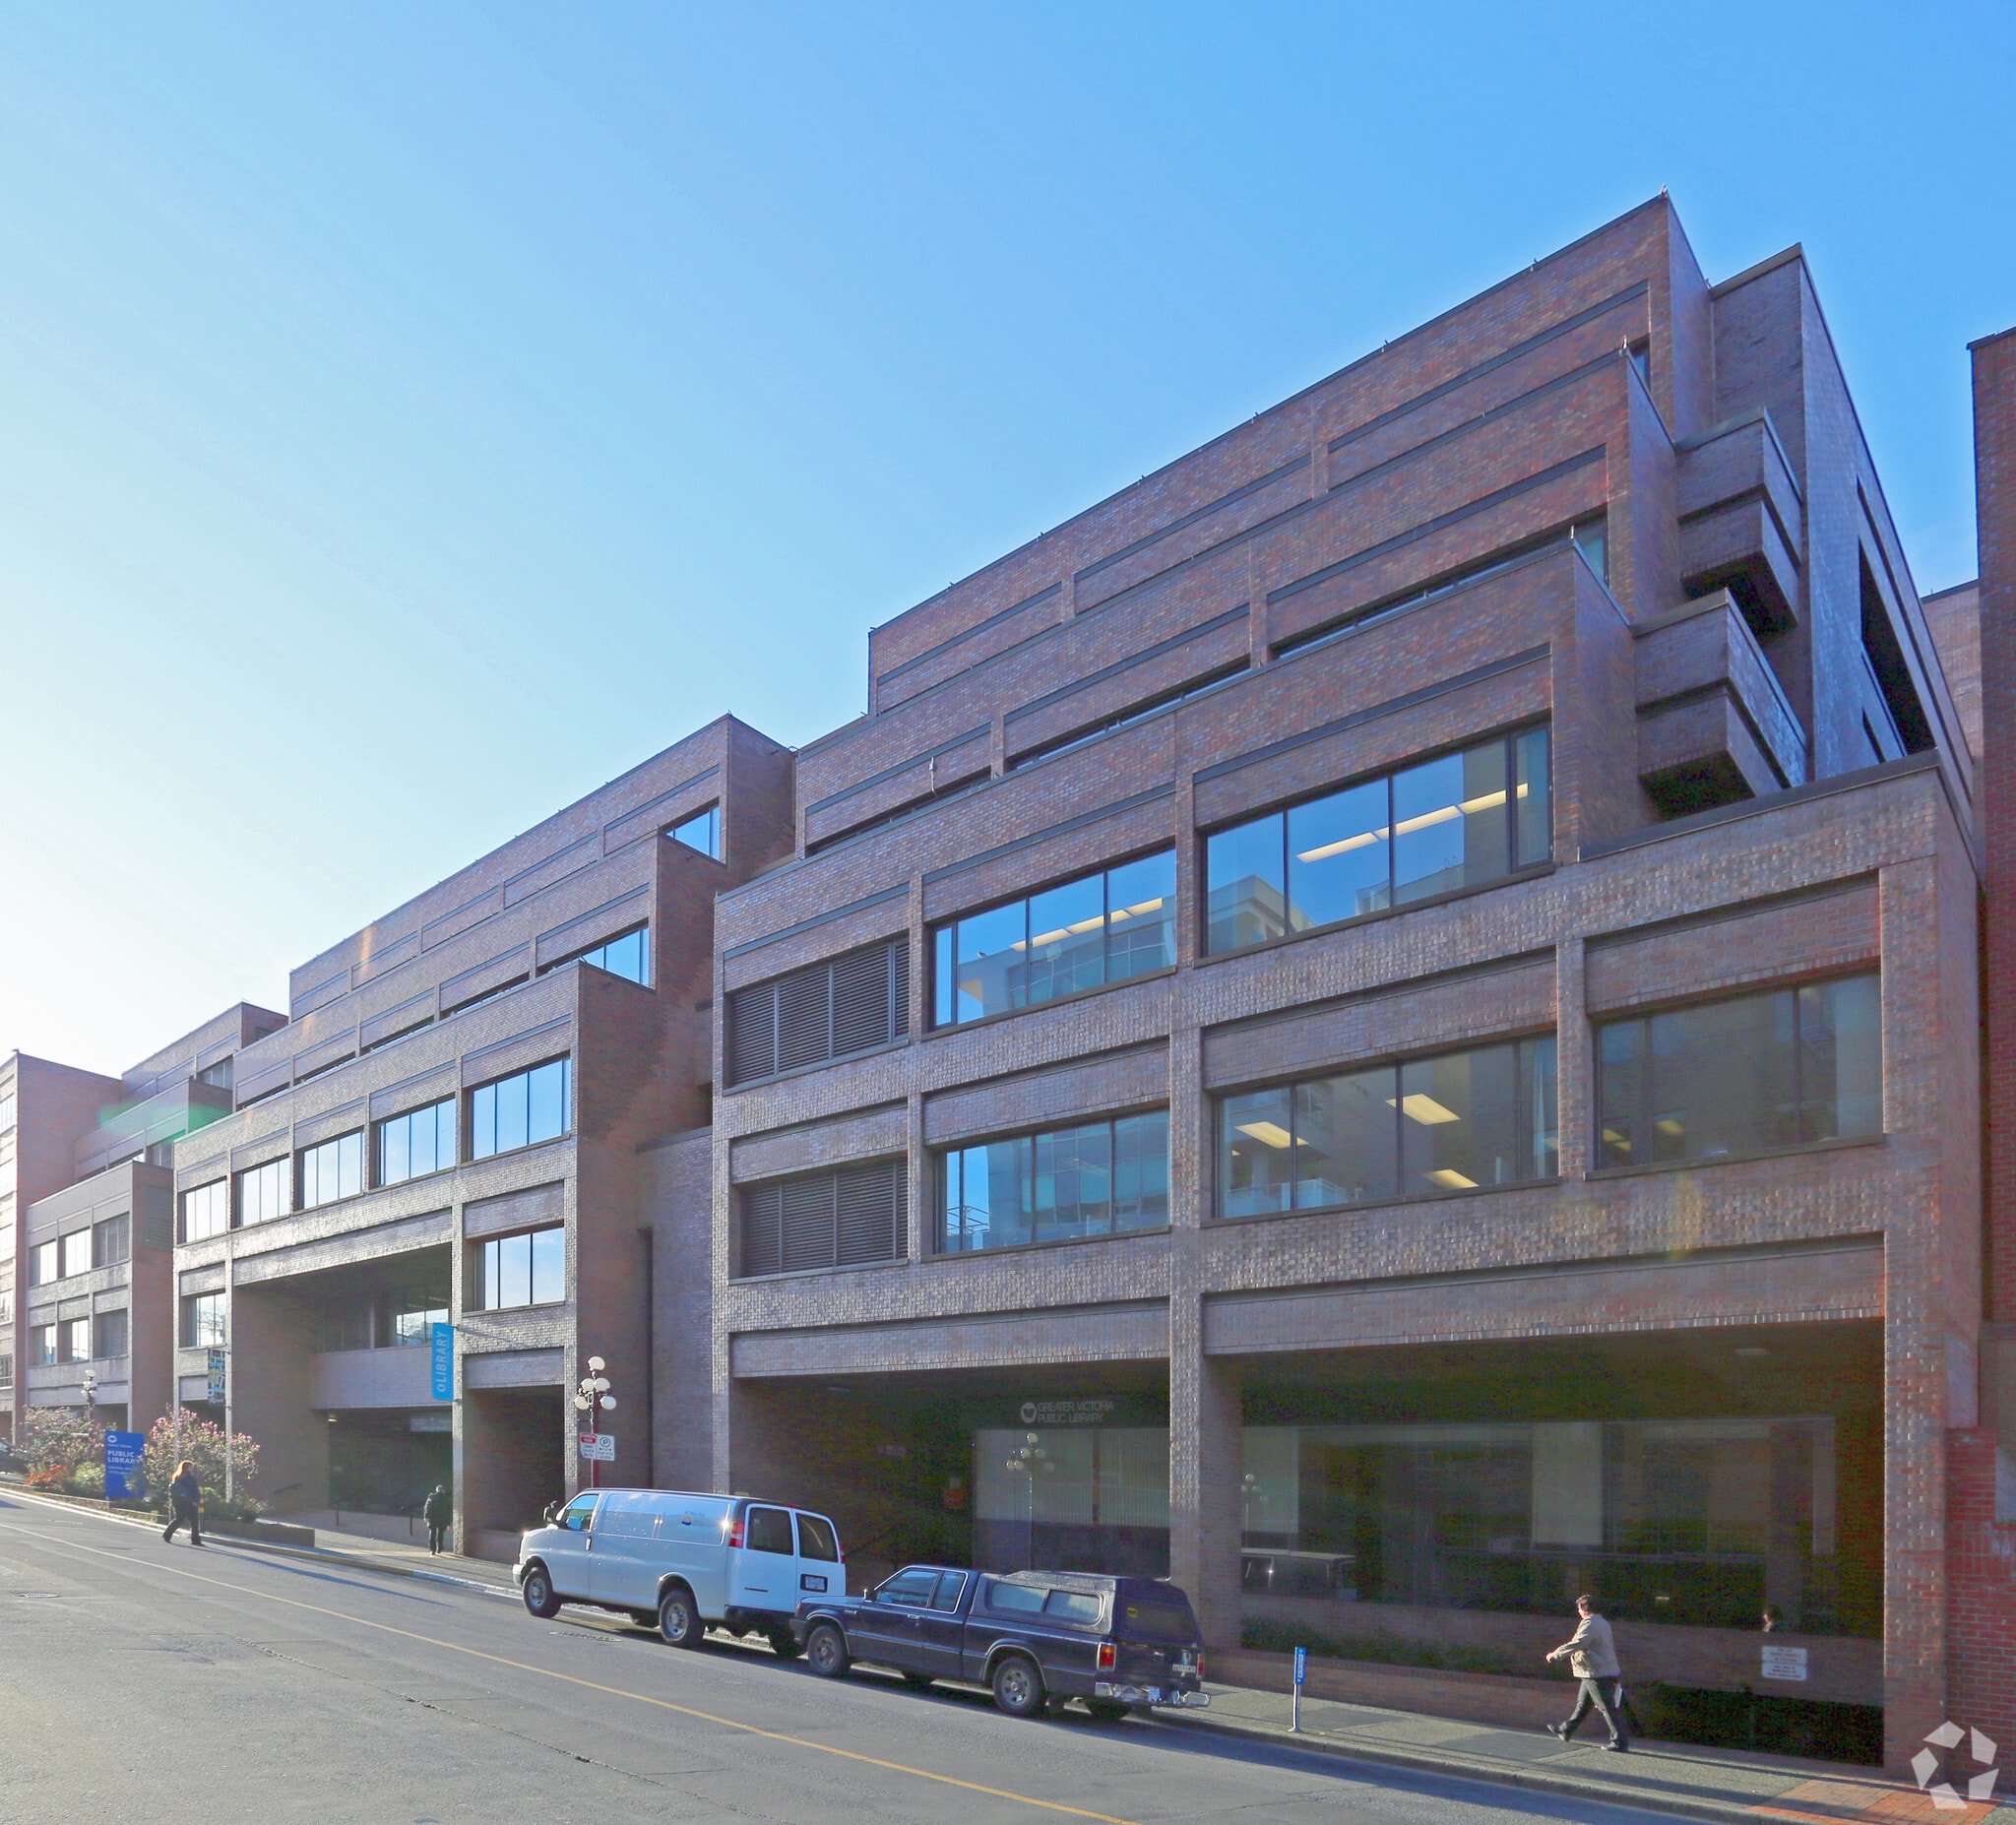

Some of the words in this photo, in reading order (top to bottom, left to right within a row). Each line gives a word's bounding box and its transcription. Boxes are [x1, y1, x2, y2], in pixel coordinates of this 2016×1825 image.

[1038, 1402, 1074, 1412] GREATER
[1077, 1401, 1114, 1411] VICTORIA
[1038, 1413, 1066, 1423] PUBLIC
[1069, 1412, 1104, 1422] LIBRARY
[1172, 1664, 1196, 1673] mazda
